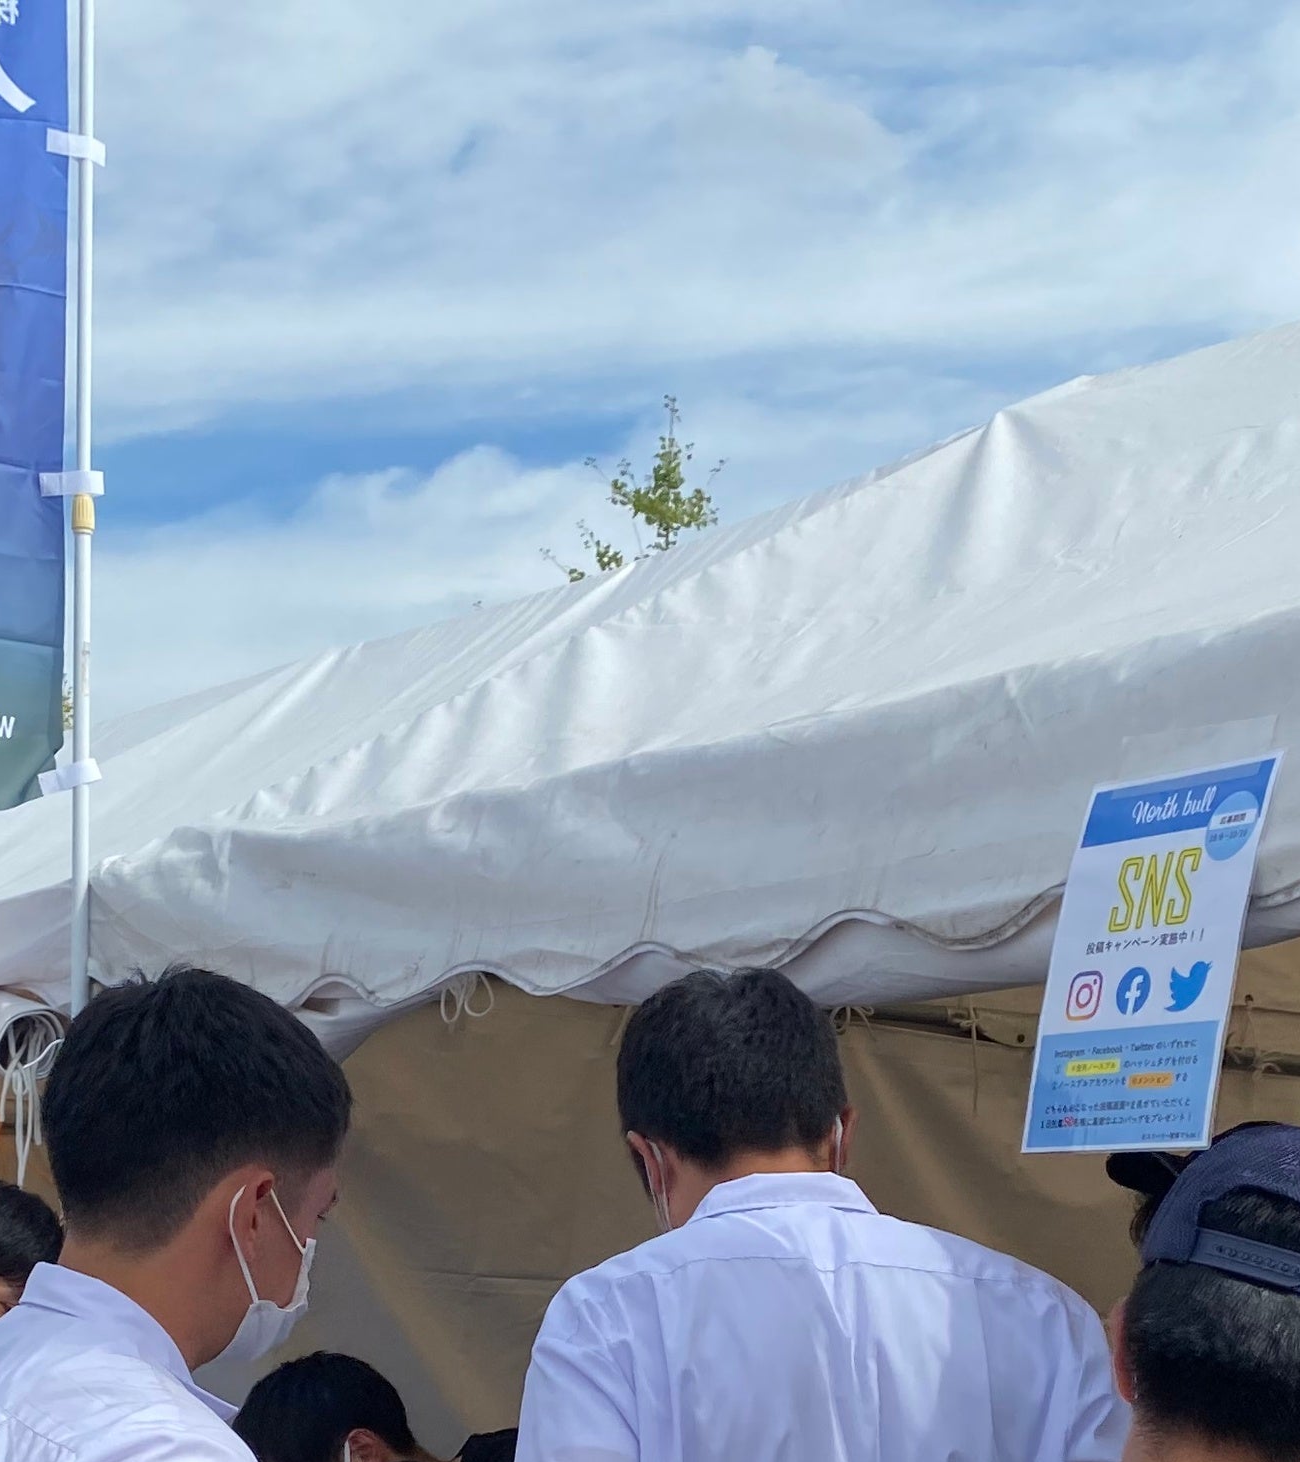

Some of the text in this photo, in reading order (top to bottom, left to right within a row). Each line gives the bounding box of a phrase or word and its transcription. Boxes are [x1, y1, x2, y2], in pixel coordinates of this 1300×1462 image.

[1132, 785, 1217, 825] North bull
[1108, 847, 1202, 933] SNS
